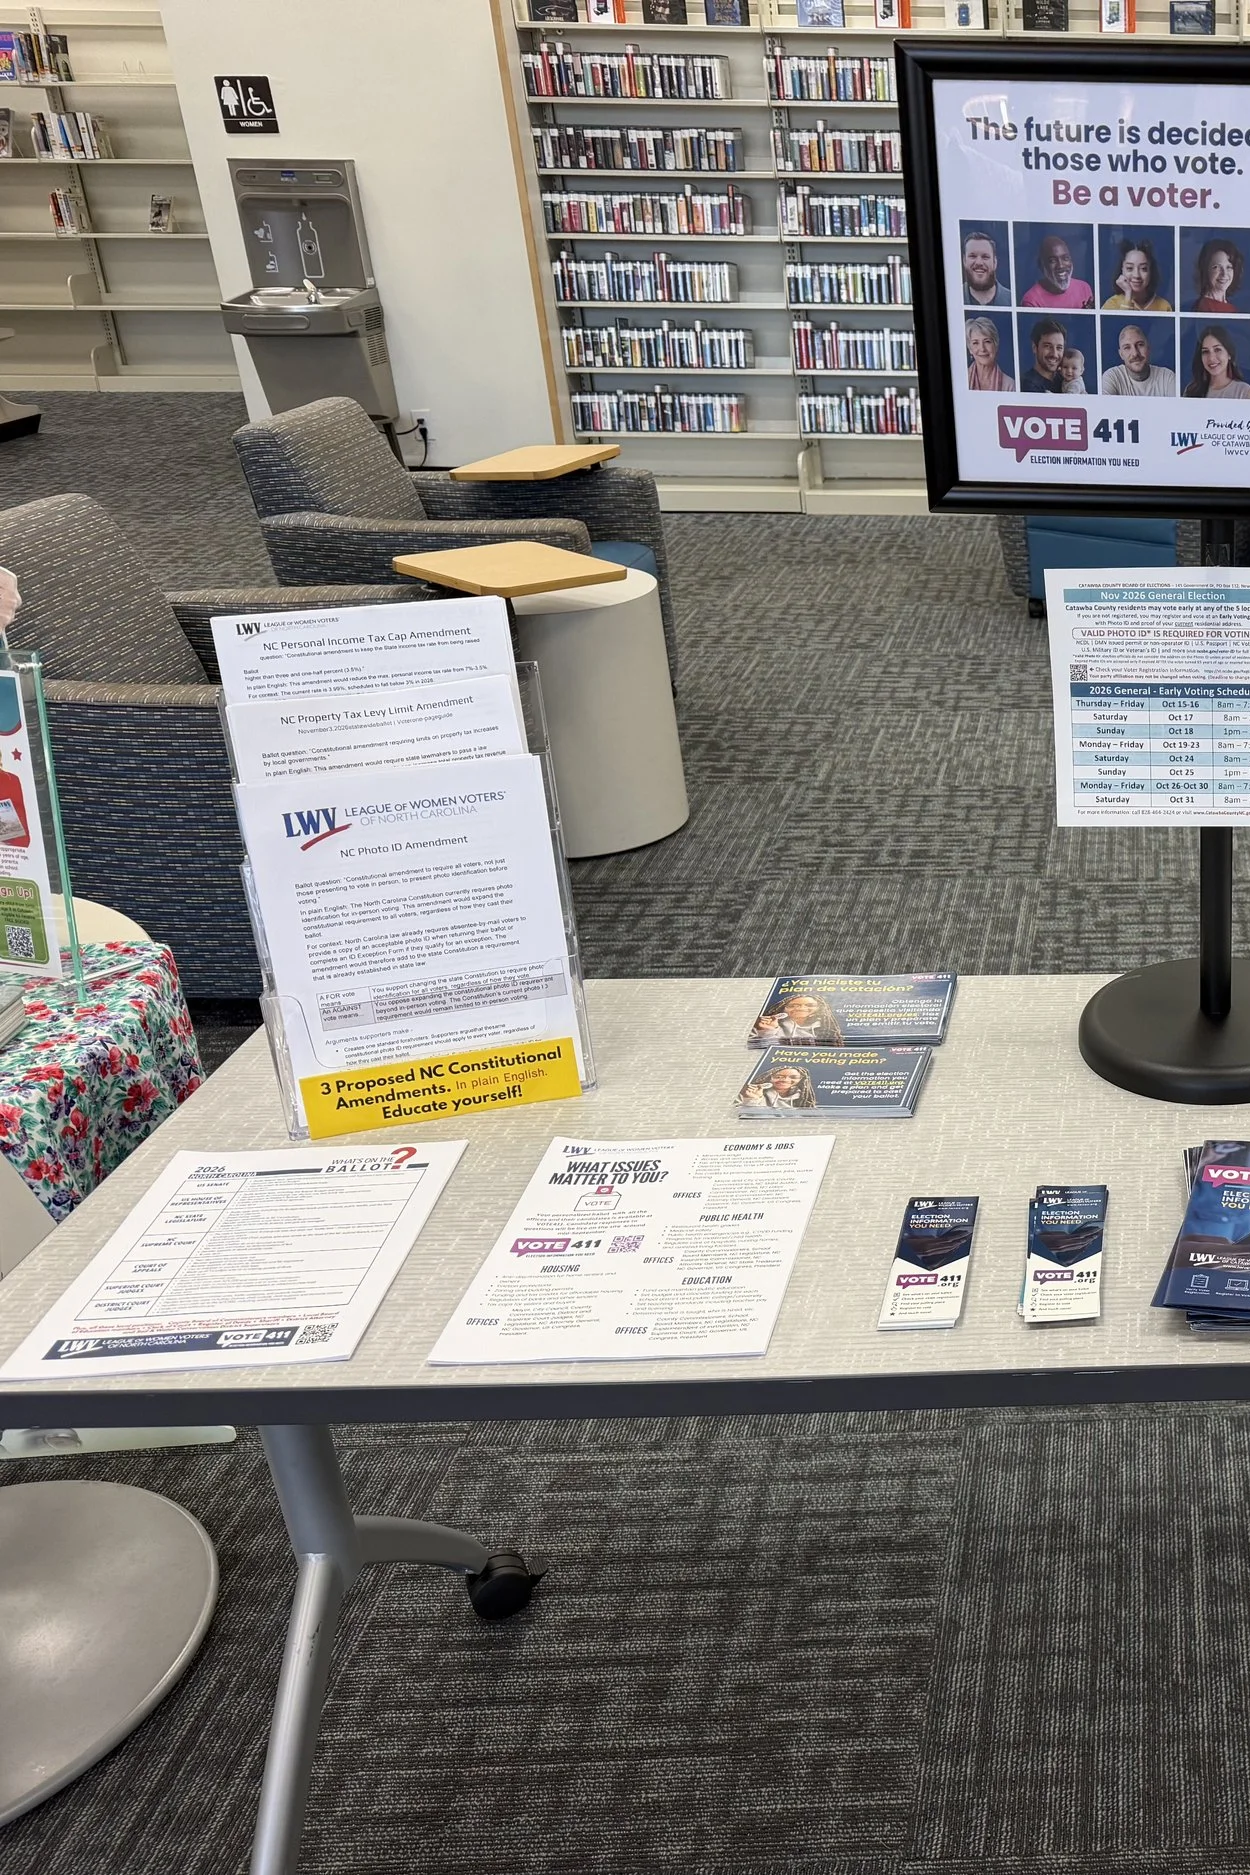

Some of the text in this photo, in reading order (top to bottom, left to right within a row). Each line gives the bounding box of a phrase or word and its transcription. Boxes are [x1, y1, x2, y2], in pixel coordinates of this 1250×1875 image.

[966, 118, 1018, 141] The
[1025, 119, 1111, 144] future
[1119, 120, 1141, 145] is
[1022, 148, 1243, 176] those who vote.
[1053, 180, 1220, 210] Be a voter.
[1003, 417, 1139, 443] VOTE 411
[1206, 419, 1243, 430] Provided
[1171, 432, 1198, 447] LWV
[1030, 455, 1140, 467] ELECTION INFORMATION YOU NEED
[1124, 592, 1145, 600] 2026
[1148, 592, 1185, 600] General
[1188, 592, 1225, 600] Election
[263, 627, 471, 652] NC Personal Income Tax Cap Amendment
[1107, 630, 1136, 638] PHOTO
[1154, 630, 1161, 638] IS
[1163, 630, 1203, 639] REQUIRED
[1090, 687, 1111, 695] 2026
[1114, 687, 1151, 695] General
[1159, 687, 1181, 696] Early
[1184, 688, 1214, 697] Voting
[1076, 700, 1112, 708] Thursday
[1121, 700, 1144, 708] Friday
[280, 695, 473, 726] NC Property Tax Levy Limit Amendment
[1093, 713, 1128, 722] Saturday
[345, 791, 506, 818] LEAGUE OF WOMEN VOTERS
[282, 807, 338, 838] LWV
[340, 835, 468, 858] NC Photo ID Amendment
[16, 887, 33, 899] Up!
[804, 1057, 847, 1065] voting
[320, 1046, 562, 1095] 3 Proposed NC Constitutional
[336, 1067, 548, 1110] Amendments. In plain English.
[382, 1084, 523, 1120] Educate yourself!
[723, 1142, 795, 1152] ECONOMY & JOBS
[567, 1159, 662, 1173] WHAT ISSUES
[549, 1170, 669, 1185] MATTER TO YOU?
[583, 1199, 612, 1208] VOTE
[1221, 1202, 1246, 1210] YOU
[699, 1212, 764, 1222] PUBLIC HEALTH
[515, 1239, 602, 1251] VOTE 411
[540, 1264, 580, 1274] HOUSING
[681, 1275, 733, 1285] EDUCATION
[899, 1276, 936, 1284] VOTE
[223, 1330, 292, 1340] VOTE 411
